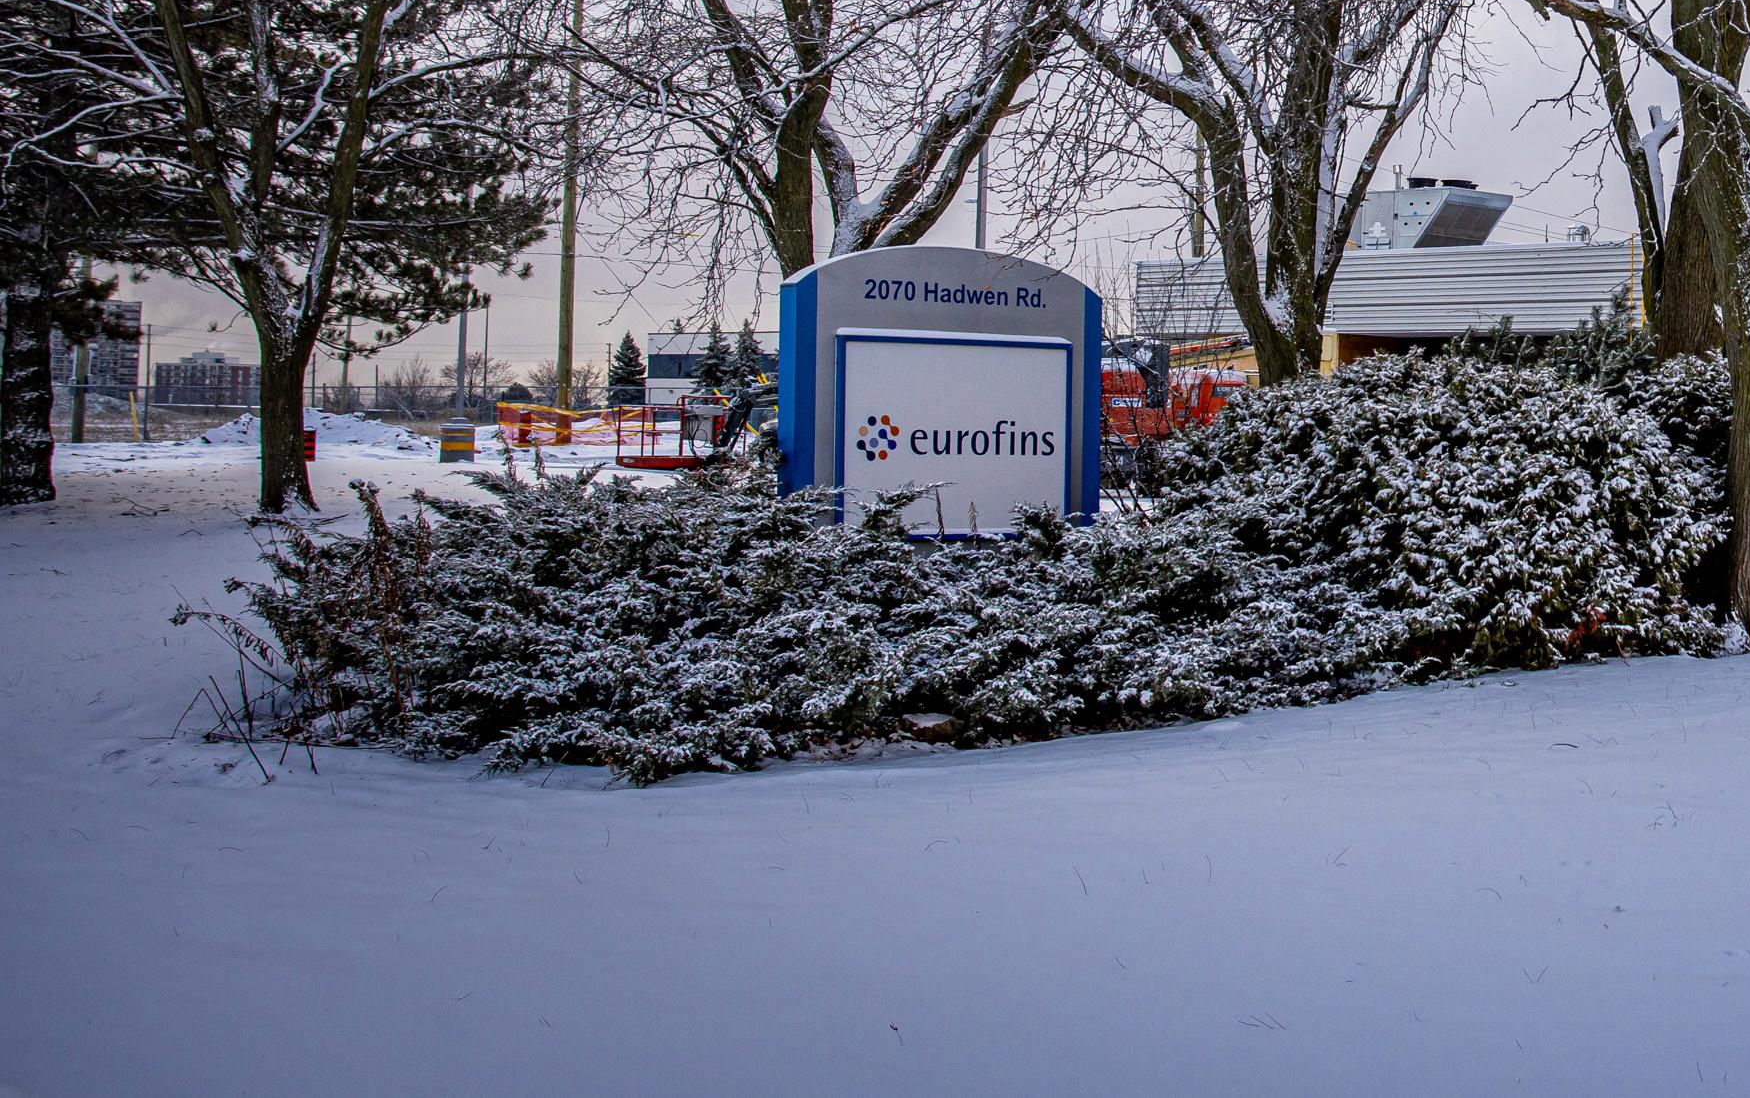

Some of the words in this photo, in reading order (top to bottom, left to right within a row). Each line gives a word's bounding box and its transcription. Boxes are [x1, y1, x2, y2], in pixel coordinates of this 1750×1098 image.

[864, 278, 916, 302] 2070
[923, 281, 1009, 307] Hadwen
[1015, 288, 1047, 309] Rd.
[909, 419, 1056, 457] eurofins
